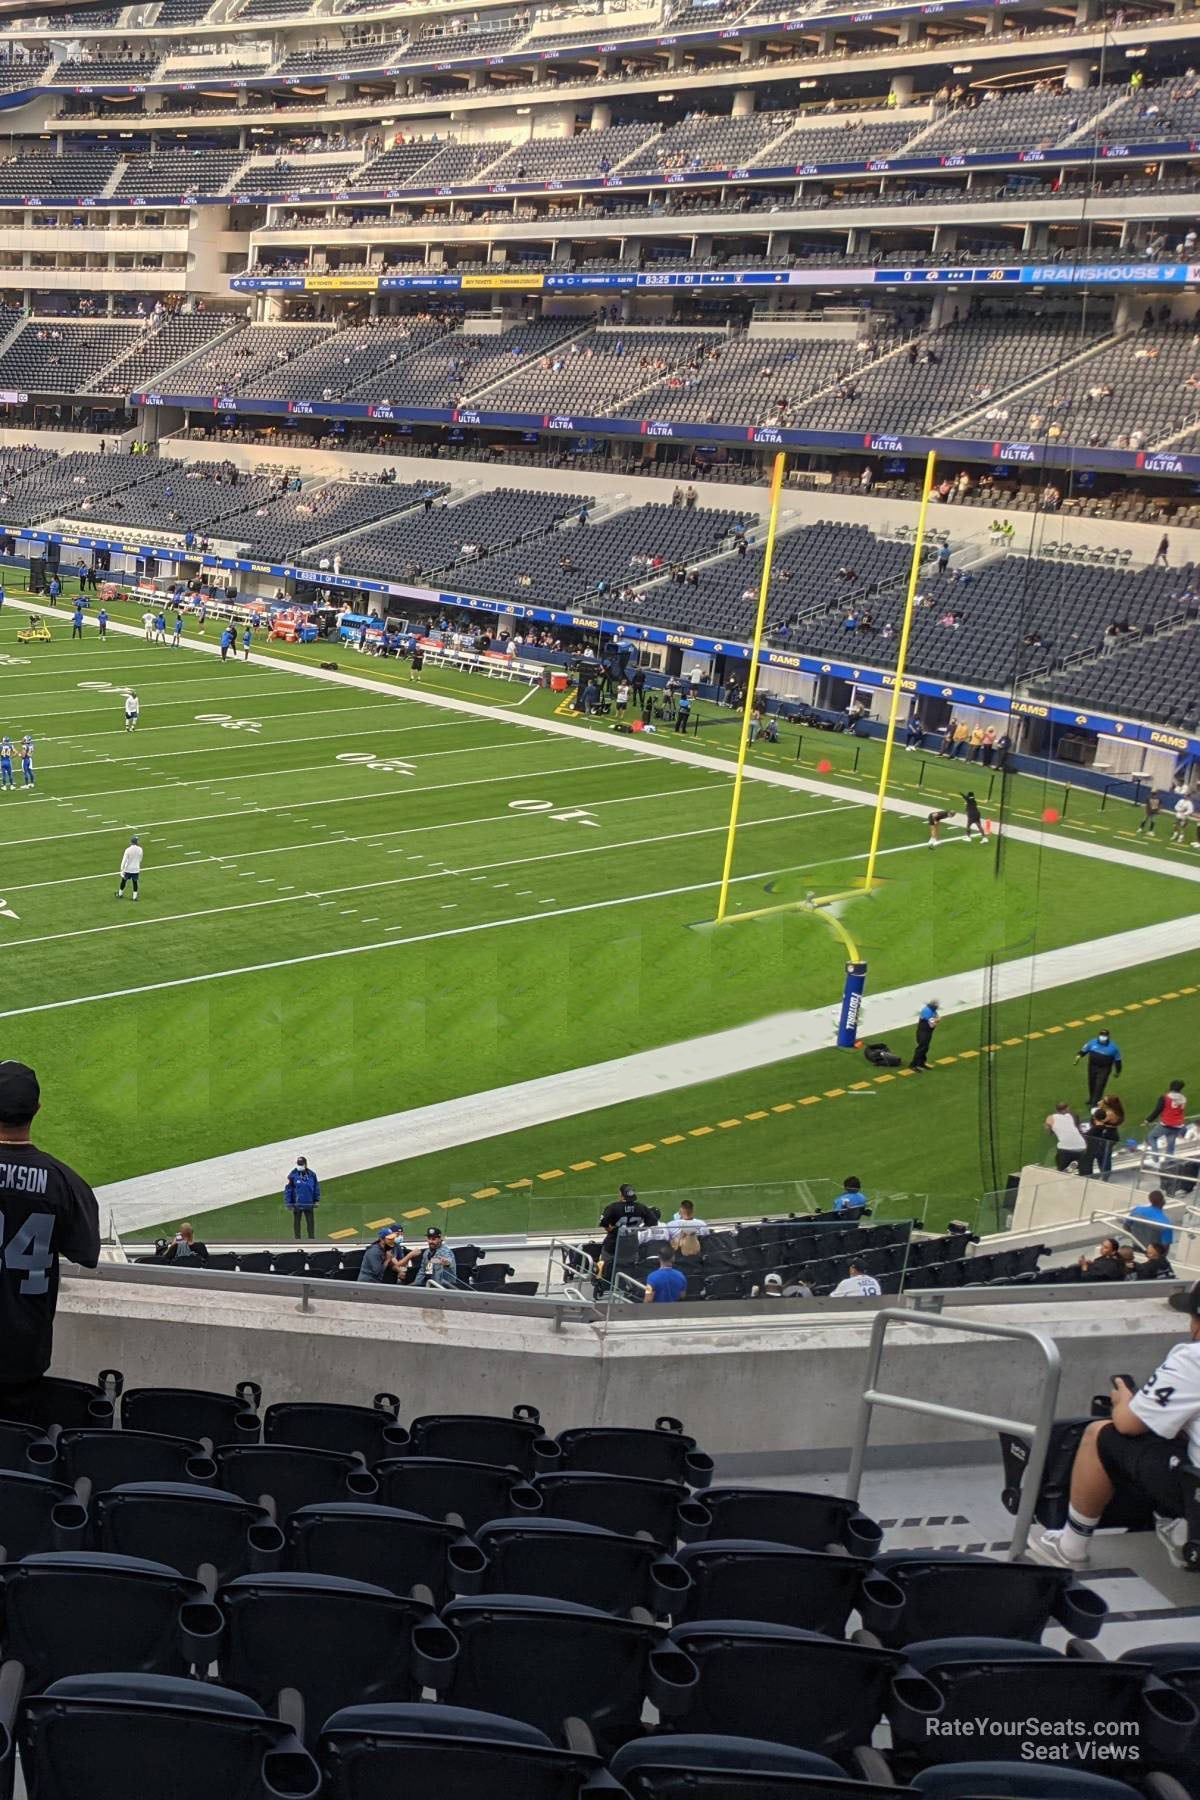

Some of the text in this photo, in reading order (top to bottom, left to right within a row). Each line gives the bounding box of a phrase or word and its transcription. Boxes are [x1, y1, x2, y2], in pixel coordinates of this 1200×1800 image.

[1031, 266, 1159, 280] #RAMSHOUSE
[145, 398, 164, 406] ULTRA
[217, 401, 237, 409] ULTRA
[293, 405, 313, 414] ULTRA
[372, 410, 394, 419] ULTRA
[458, 415, 480, 424] ULTRA
[549, 420, 573, 430] ULTRA
[647, 426, 673, 436] ULTRA
[753, 433, 782, 443] ULTRA
[871, 440, 903, 451] ULTRA
[1000, 449, 1035, 461] ULTRA
[1144, 459, 1183, 472] ULTRA
[251, 564, 271, 573] RAMS
[572, 617, 599, 629] RAMS
[666, 634, 694, 647] RAMS
[769, 653, 800, 667] RAMS
[1010, 702, 1048, 718] RAMS
[1151, 731, 1188, 749] RAMS
